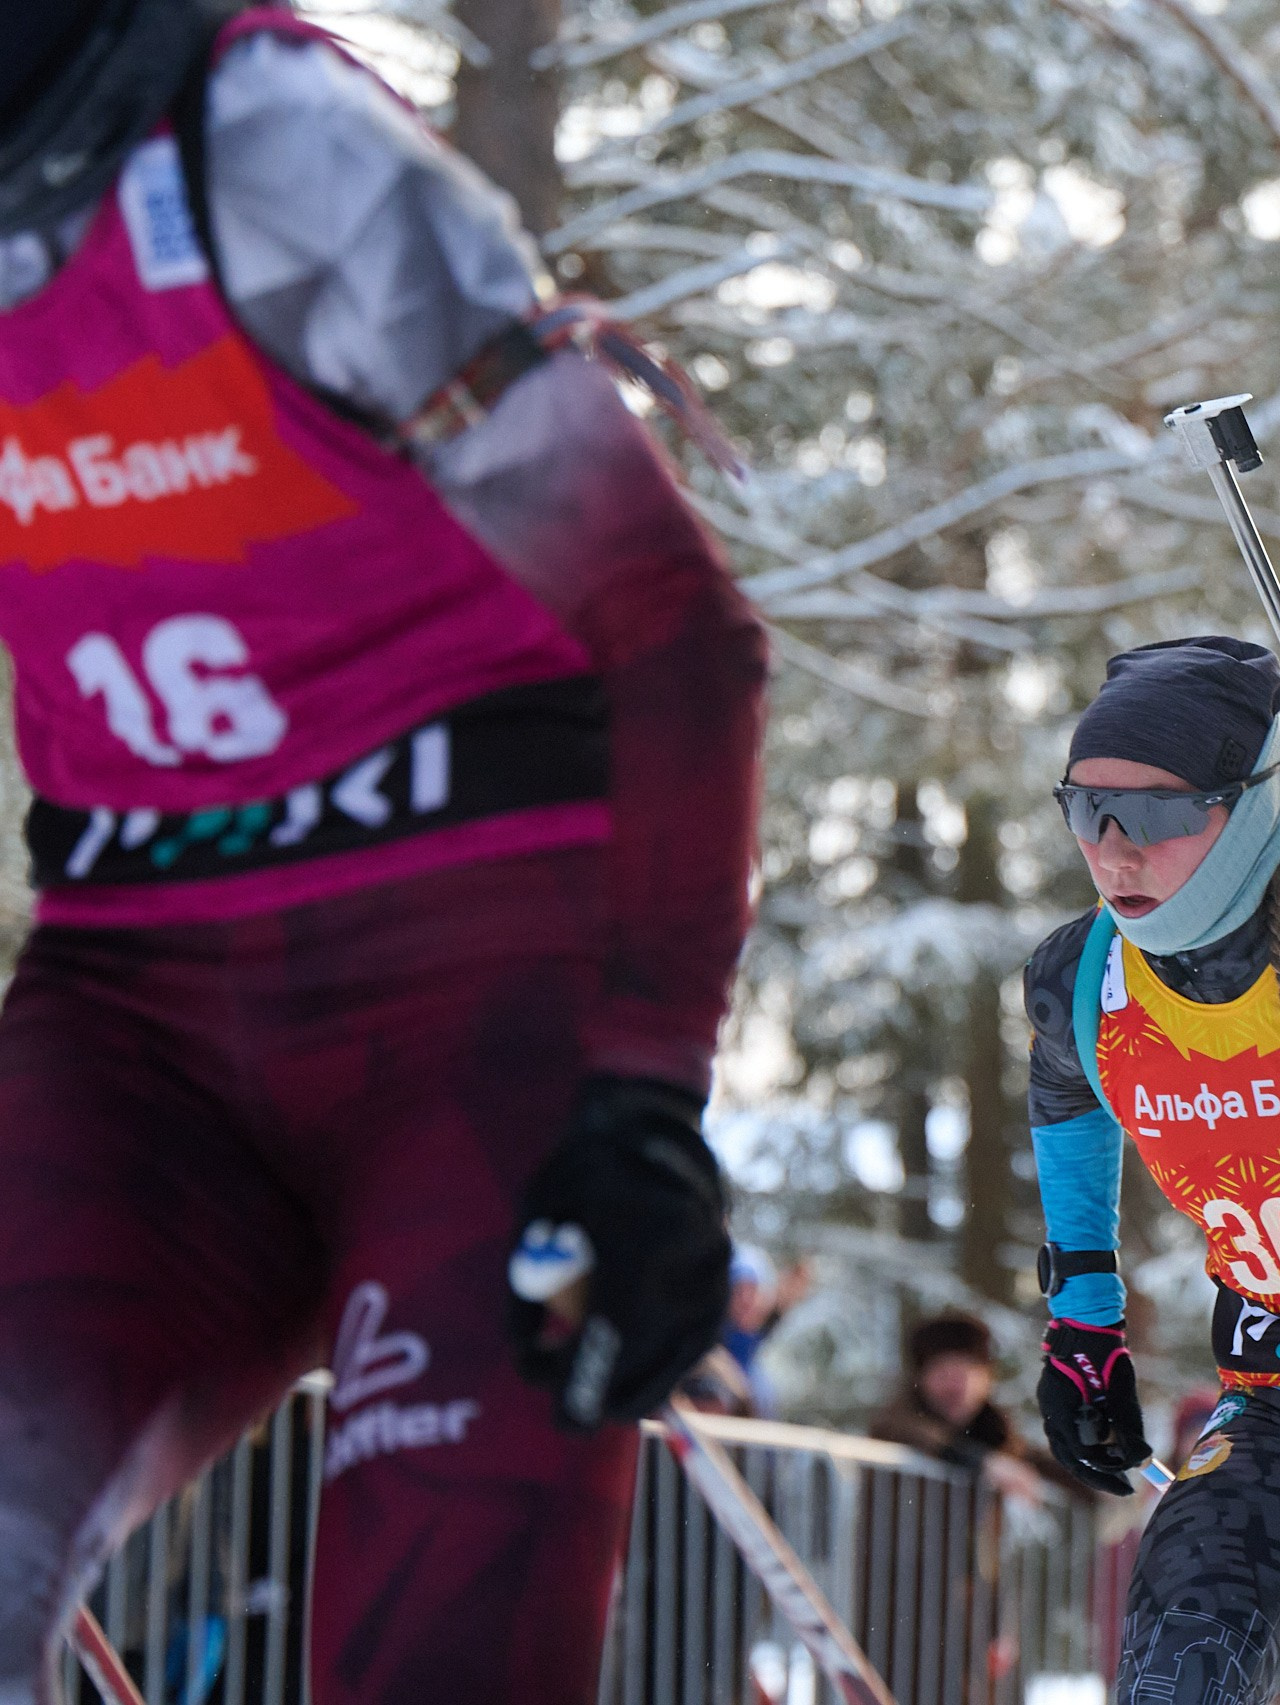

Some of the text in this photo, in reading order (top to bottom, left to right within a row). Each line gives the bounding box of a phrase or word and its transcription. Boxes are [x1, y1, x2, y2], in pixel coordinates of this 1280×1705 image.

[67, 422, 260, 508] Банк
[67, 613, 289, 767] 16
[1135, 1083, 1248, 1131] Альфа
